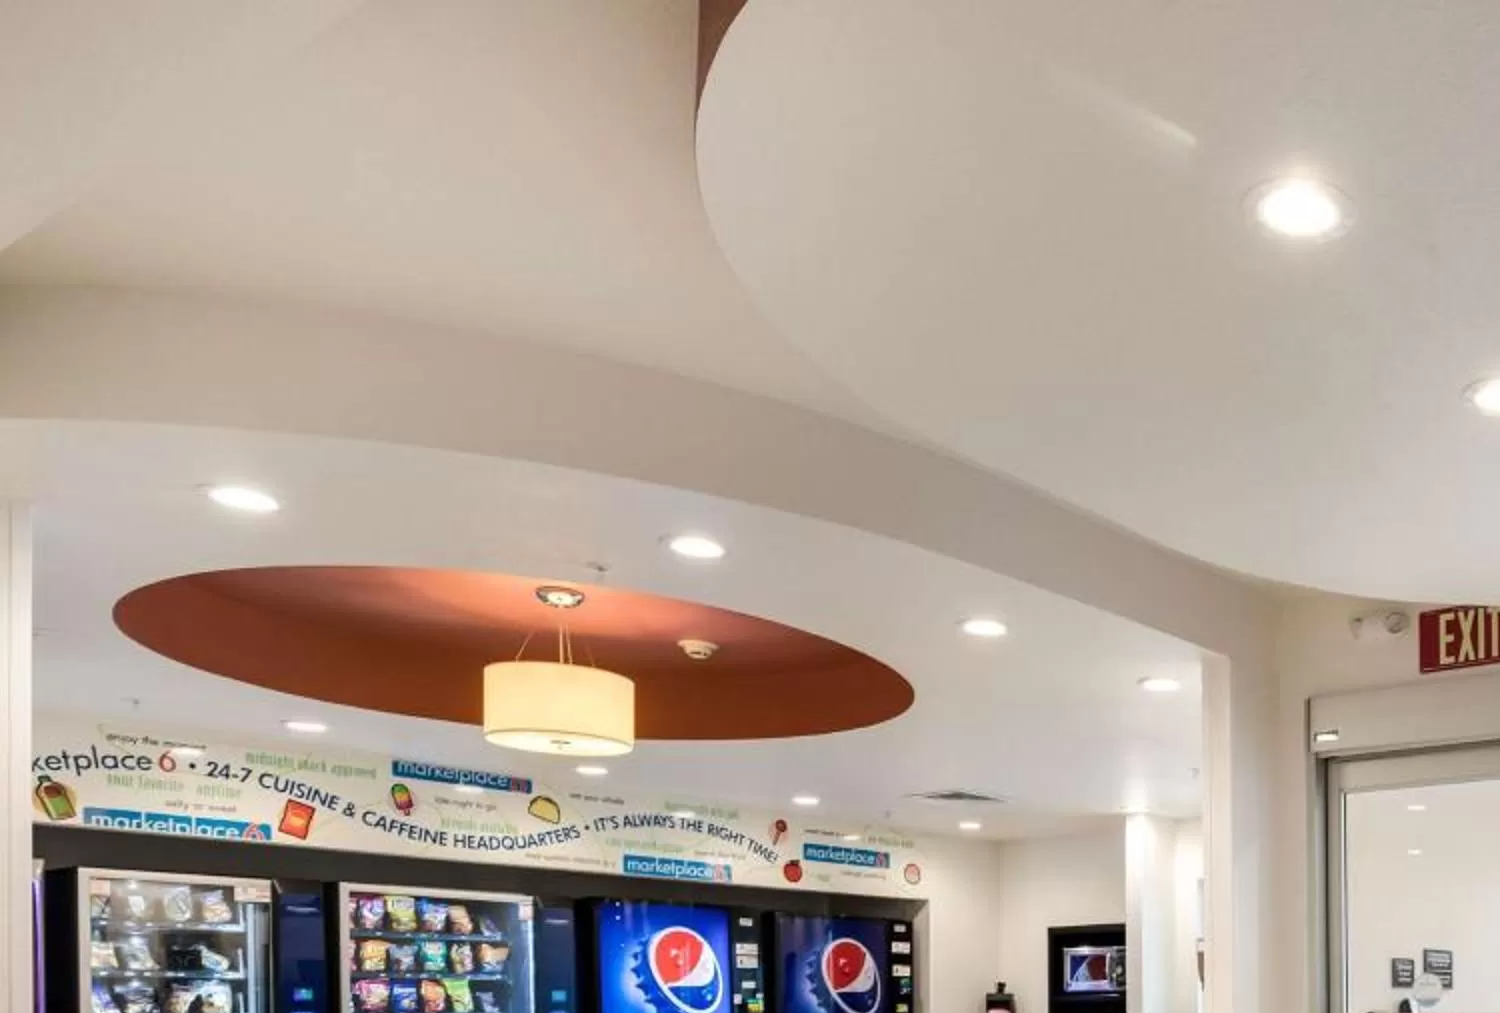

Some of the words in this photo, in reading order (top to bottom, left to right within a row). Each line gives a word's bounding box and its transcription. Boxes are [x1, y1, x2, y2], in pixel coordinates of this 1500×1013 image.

[397, 761, 509, 786] marketplace
[159, 750, 176, 772] 6
[207, 761, 252, 784] 24-7
[258, 773, 341, 812] CUISINE
[342, 802, 356, 818] &
[362, 811, 449, 847] CAFFEINE
[453, 825, 582, 851] HEADQUARTERS
[593, 815, 619, 833] IT'S
[623, 812, 676, 829] ALWAYS
[680, 818, 704, 833] THE
[707, 823, 746, 846] RIGHT
[749, 837, 779, 864] TIME!
[91, 810, 241, 842] marketplace
[627, 855, 712, 879] marketplace
[806, 847, 875, 865] marketplace
